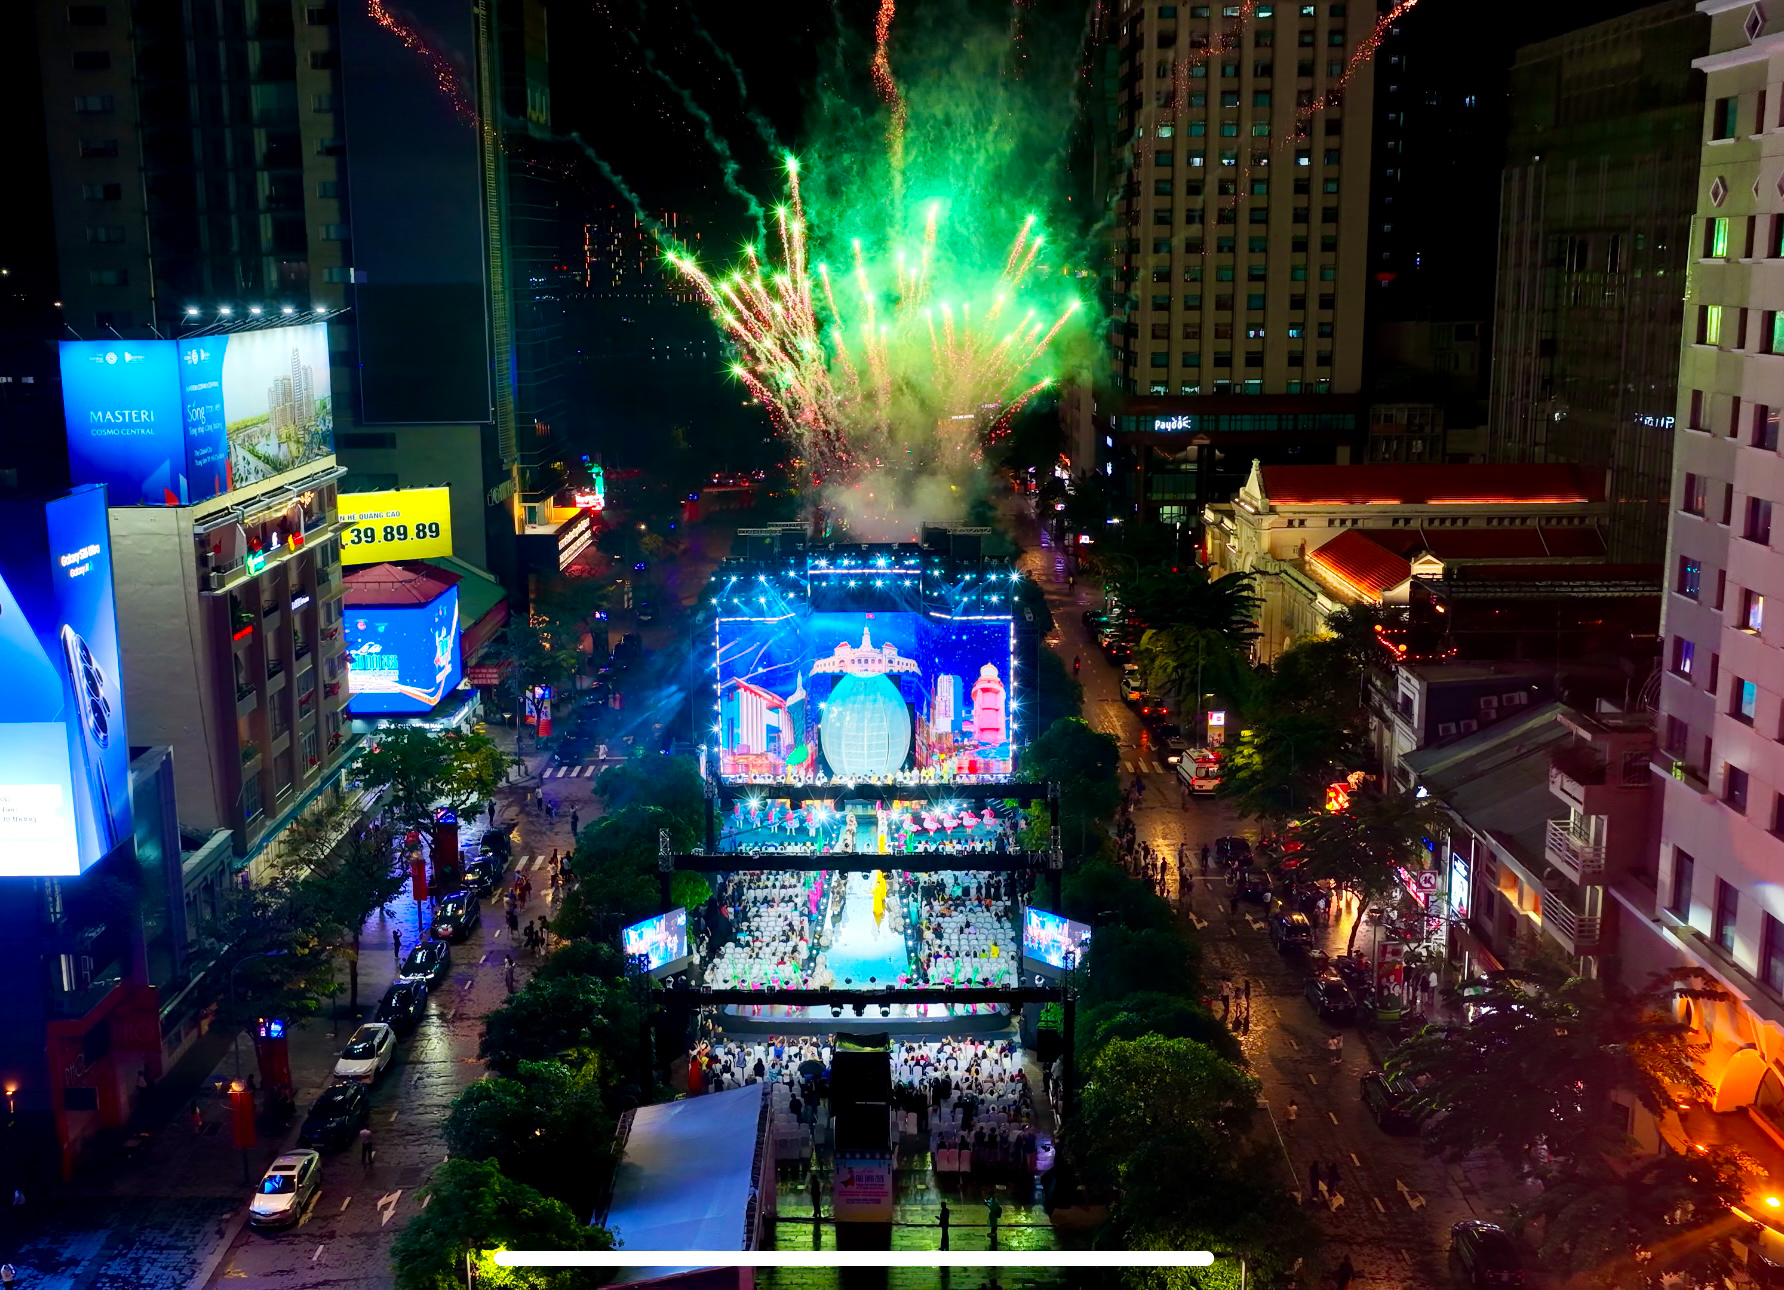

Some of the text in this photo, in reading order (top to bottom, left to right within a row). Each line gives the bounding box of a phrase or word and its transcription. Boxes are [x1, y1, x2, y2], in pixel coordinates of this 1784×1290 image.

[89, 410, 154, 423] MASTERI
[91, 428, 155, 436] COSMO CENTRAL
